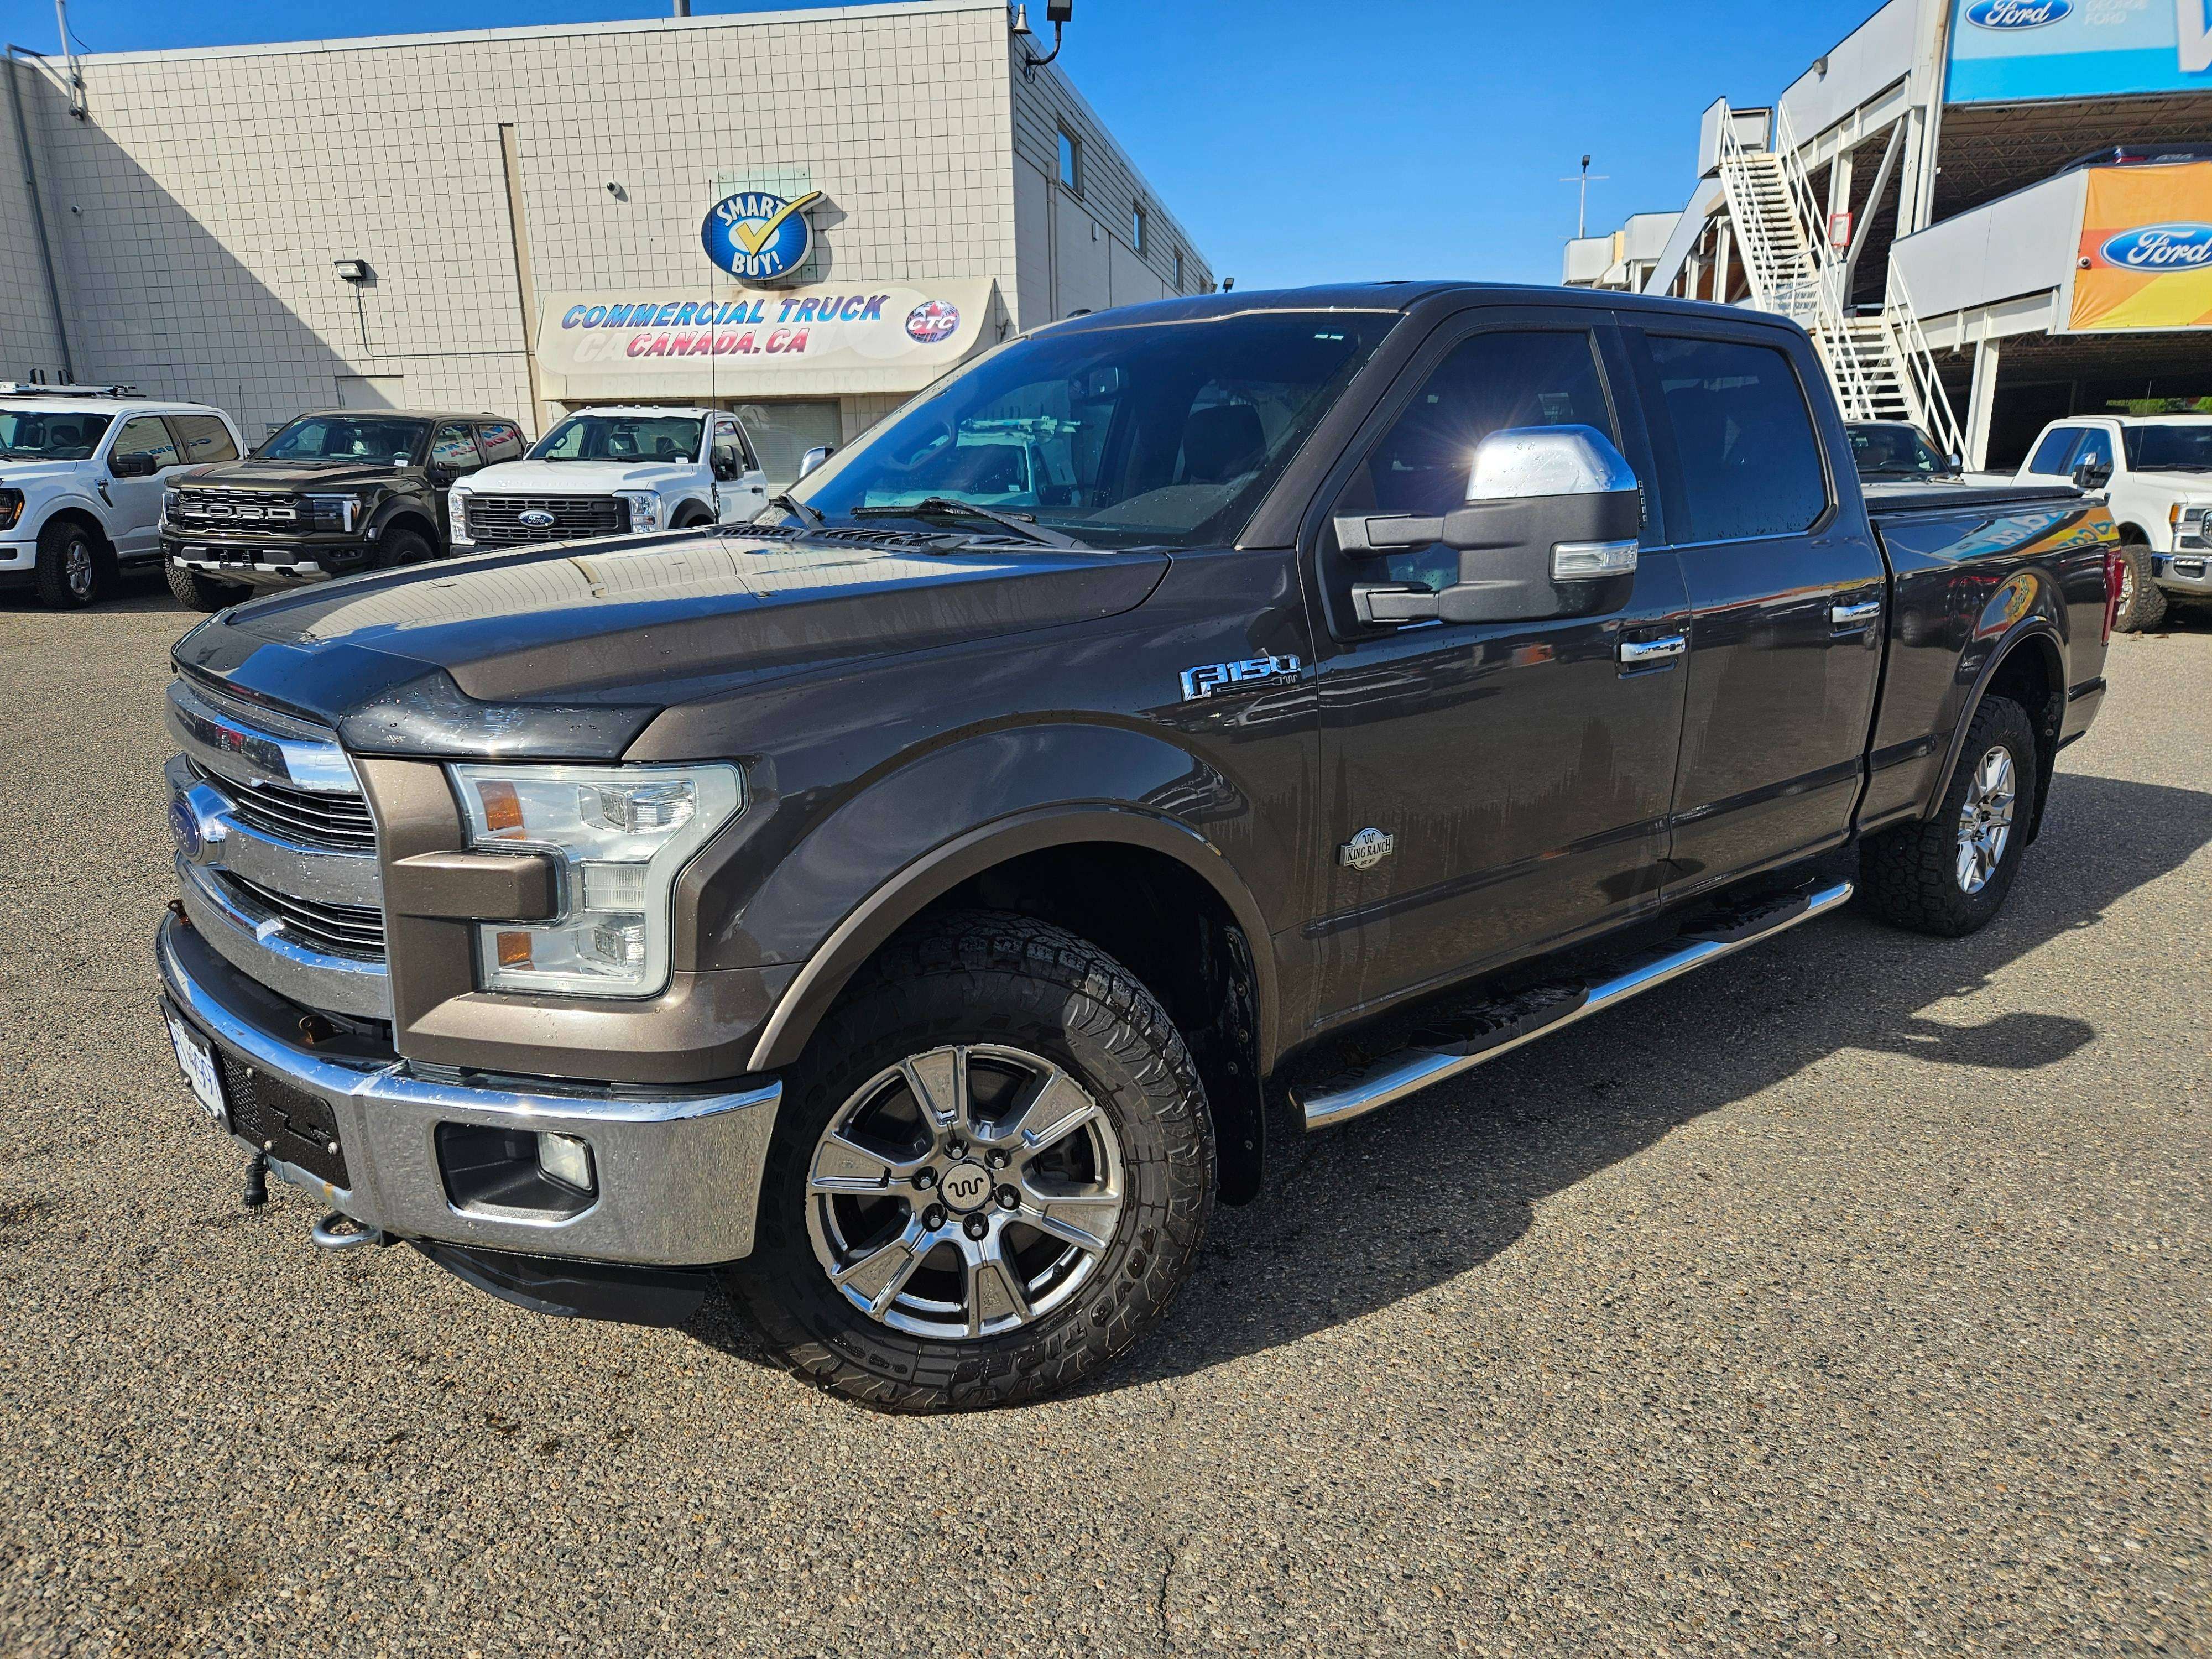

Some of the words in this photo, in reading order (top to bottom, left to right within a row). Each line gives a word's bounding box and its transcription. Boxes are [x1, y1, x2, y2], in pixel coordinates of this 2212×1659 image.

[1985, 0, 2051, 24] Ford
[716, 195, 787, 227] SMART
[2127, 230, 2212, 264] Ford
[731, 250, 784, 276] BUY!
[561, 299, 765, 329] COMMERCIAL
[777, 295, 890, 323] TRUCK
[907, 315, 956, 331] CTC
[626, 328, 810, 357] CANADA.CA
[179, 504, 298, 520] FORD
[527, 515, 546, 524] Ford
[1348, 847, 1365, 861] KING
[1367, 838, 1390, 857] RANCH
[1089, 1223, 1157, 1328] TOYO
